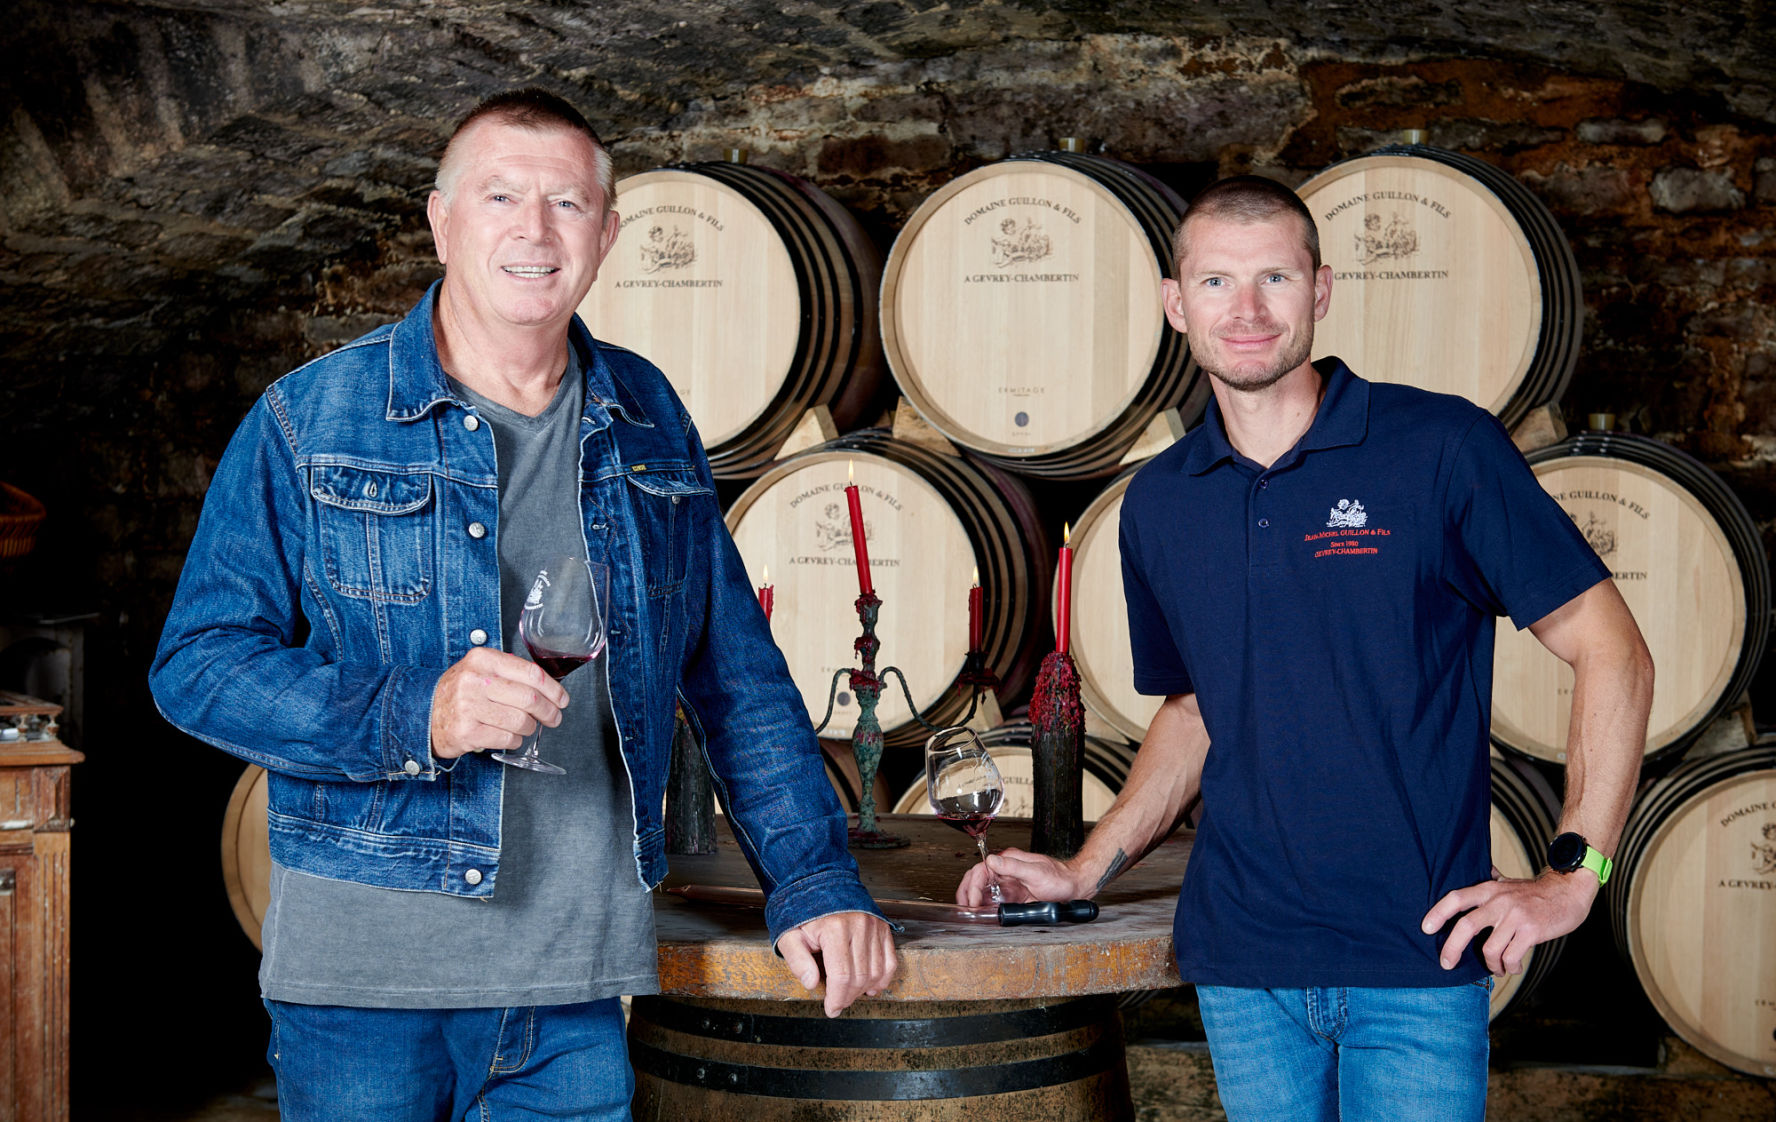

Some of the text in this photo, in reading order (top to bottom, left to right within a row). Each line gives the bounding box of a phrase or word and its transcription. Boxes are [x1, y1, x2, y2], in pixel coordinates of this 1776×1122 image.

[618, 205, 724, 232] OMAINE GUILLON & FILS
[964, 197, 1081, 226] DOMAINE GUILLON & FILS
[1325, 191, 1451, 221] DOMAINE GUILLON & FILS
[623, 280, 723, 289] GEVREY-CHAMBERTIN
[973, 273, 1079, 283] GEVREY-CHAMBERTIN
[1334, 270, 1448, 281] GEVREY-CHAMBERTIN
[790, 485, 830, 508] DOMAINE
[884, 494, 903, 511] FILS
[1569, 491, 1618, 502] GUILLON
[1619, 498, 1626, 506] &
[1628, 501, 1650, 520] FILS
[1720, 802, 1768, 828] DOMAINE
